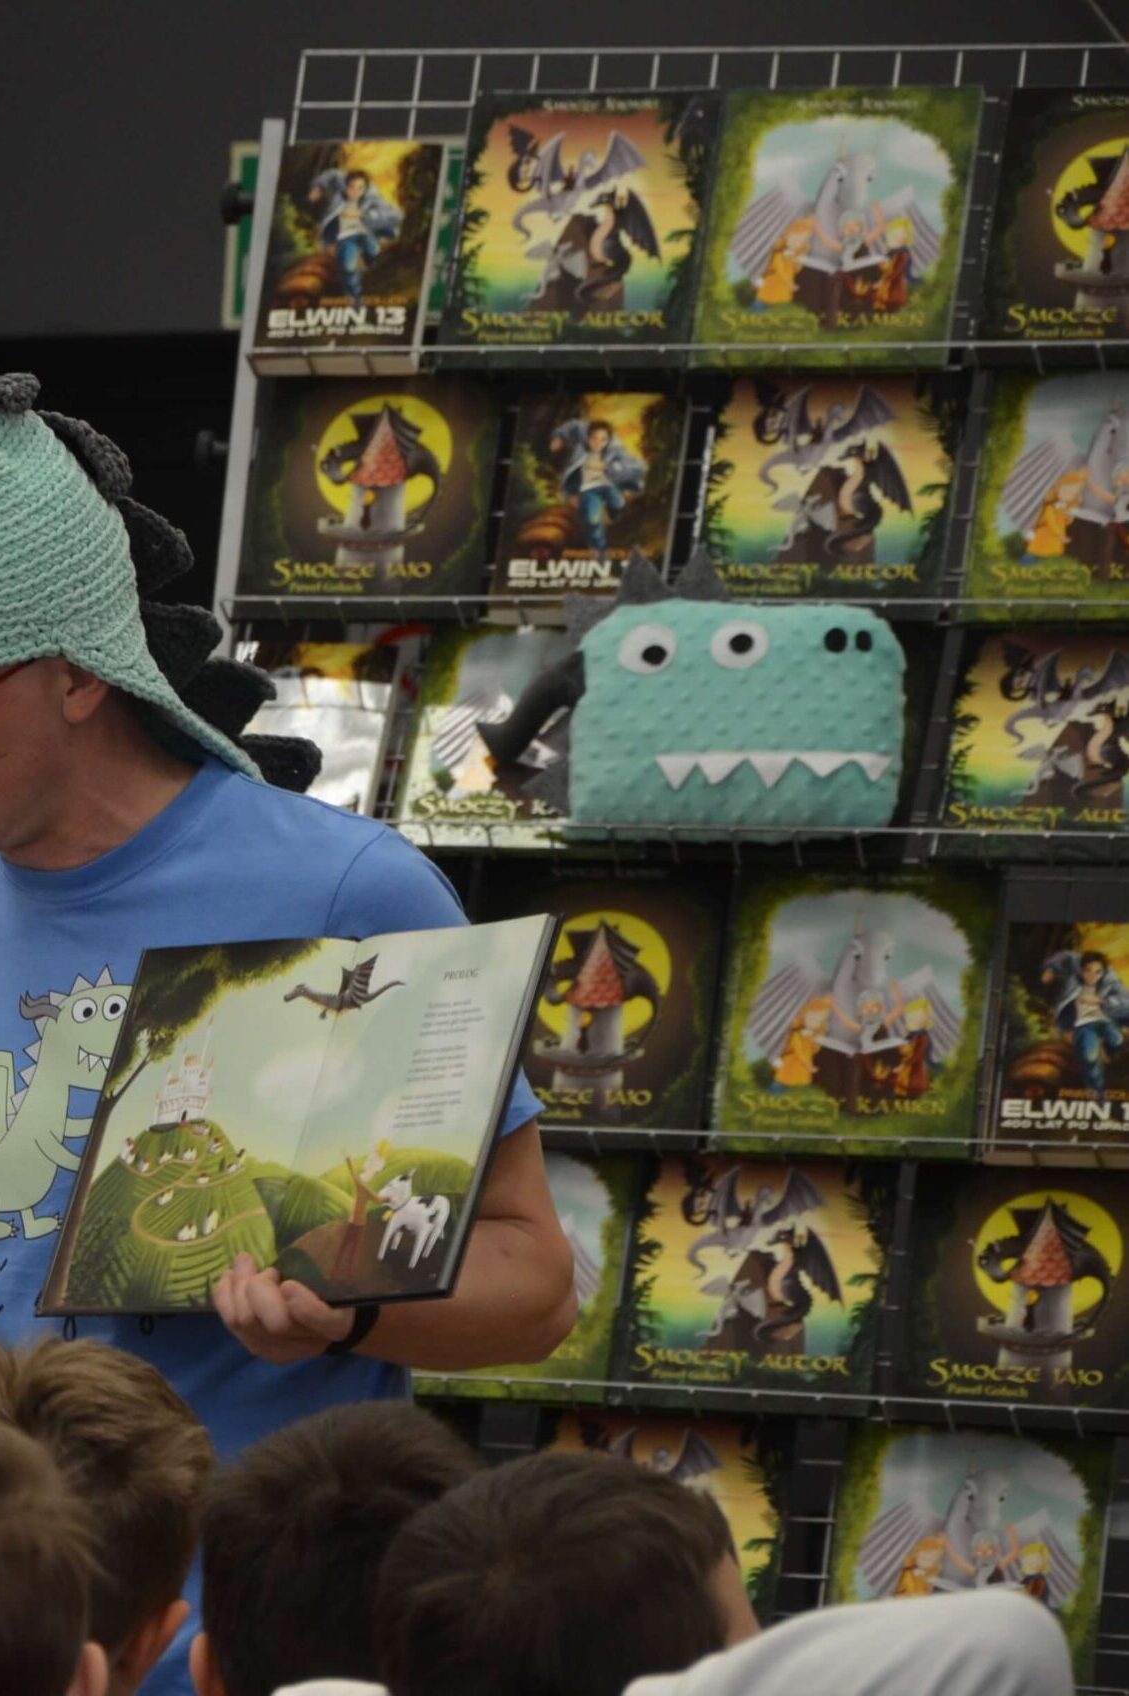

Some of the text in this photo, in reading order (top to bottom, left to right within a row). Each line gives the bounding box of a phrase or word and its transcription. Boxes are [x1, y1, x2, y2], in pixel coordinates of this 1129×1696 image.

[268, 306, 406, 328] ELWIN 13
[1003, 303, 1118, 333] SMOCZE
[270, 557, 375, 588] SMOCZE
[508, 558, 612, 578] ELWIN
[417, 795, 525, 821] SMOCZY
[945, 803, 1129, 829] SMOCZY AUT
[442, 968, 480, 982] PROLOG
[1001, 1099, 1112, 1120] ELWIN
[630, 1344, 851, 1377] SMOCZY AUTOR
[926, 1358, 1042, 1388] SMOCZE
